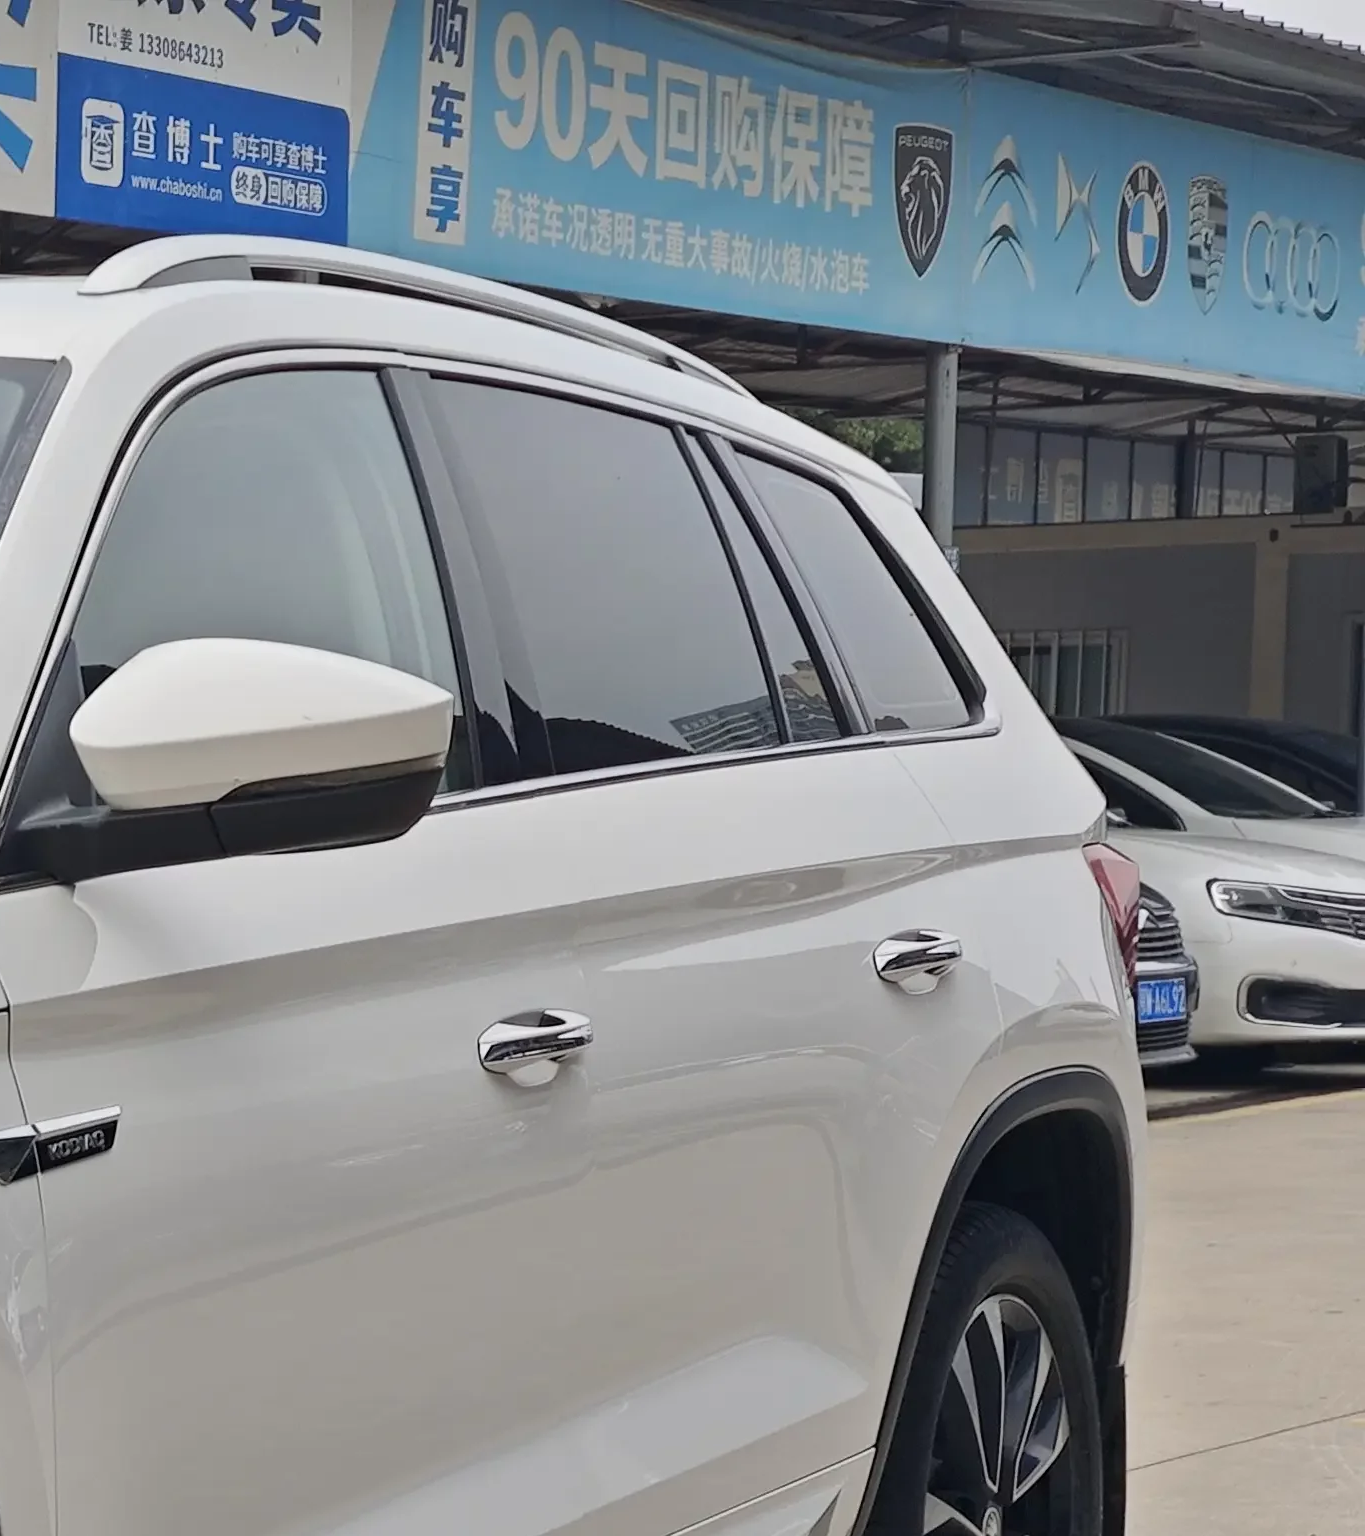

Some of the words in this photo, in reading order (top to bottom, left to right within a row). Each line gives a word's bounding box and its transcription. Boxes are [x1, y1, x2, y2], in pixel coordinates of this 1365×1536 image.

[138, 33, 224, 68] 13308643213
[427, 0, 469, 233] 购车享
[494, 12, 875, 218] 90天回购保障
[132, 111, 223, 171] 查博士
[232, 132, 327, 175] 购车可享查博士
[898, 134, 950, 152] PEUGEOT
[131, 174, 222, 203] www.chaboshi.cn
[235, 171, 263, 202] 终身
[268, 176, 323, 212] 回购保障
[1124, 168, 1165, 213] BMW
[491, 187, 635, 260] 承诺车况透明
[641, 217, 869, 295] 无重大事故/火烧/水泡车
